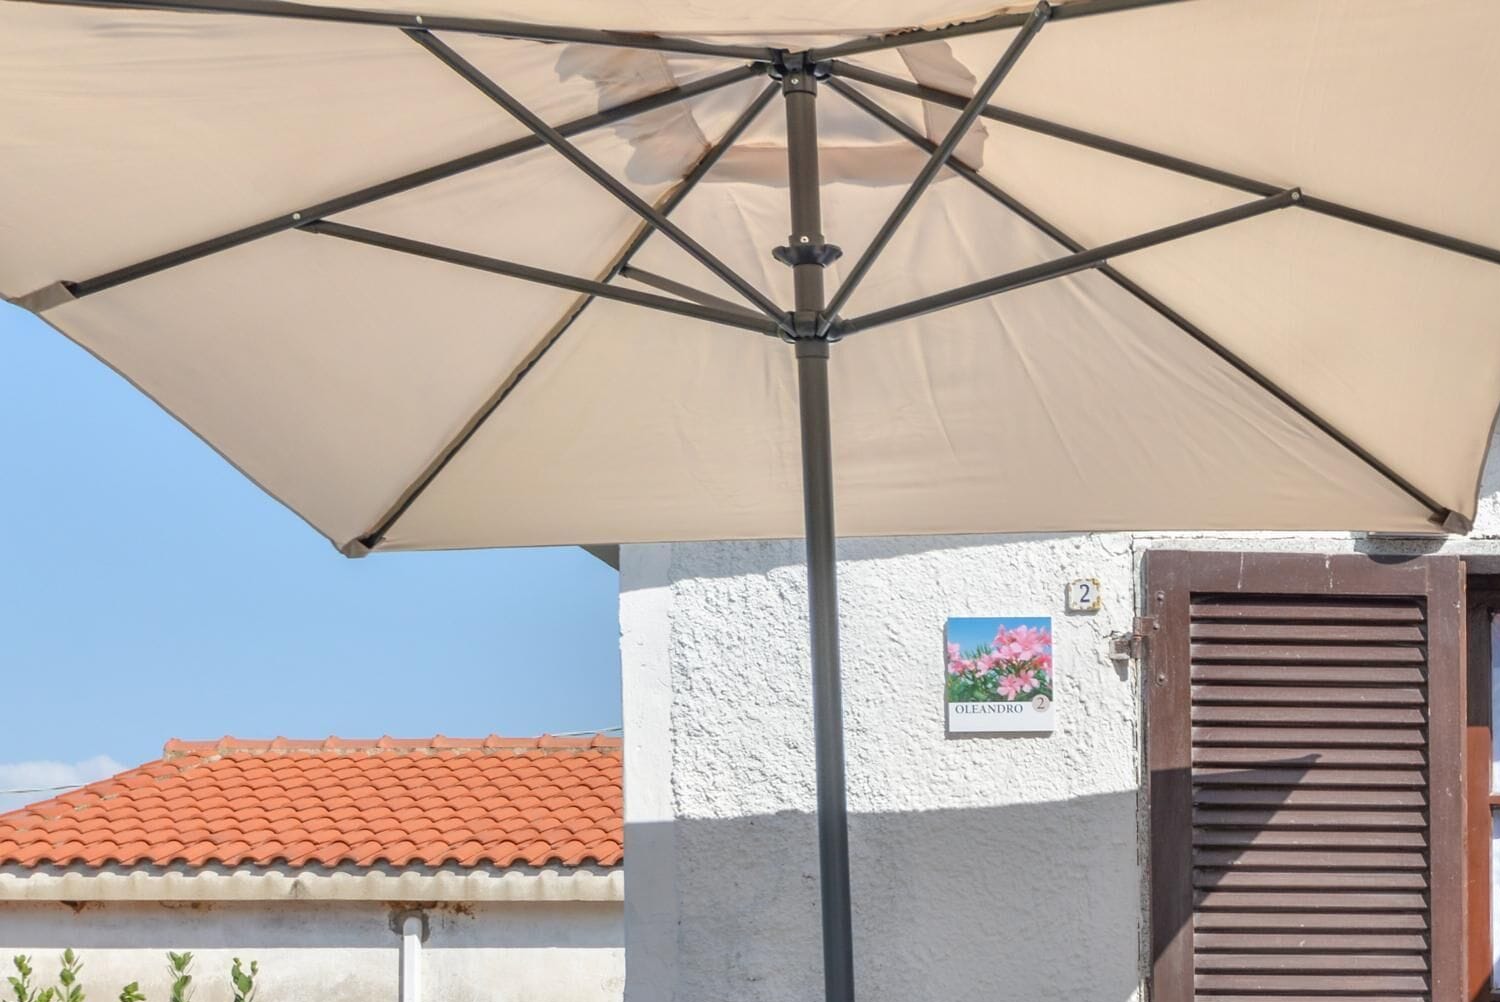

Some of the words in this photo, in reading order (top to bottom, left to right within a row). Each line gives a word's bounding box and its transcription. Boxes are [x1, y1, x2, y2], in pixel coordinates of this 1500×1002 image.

[1079, 584, 1090, 603] 2
[955, 704, 1023, 714] OLEANDRO
[1036, 697, 1045, 710] 2
